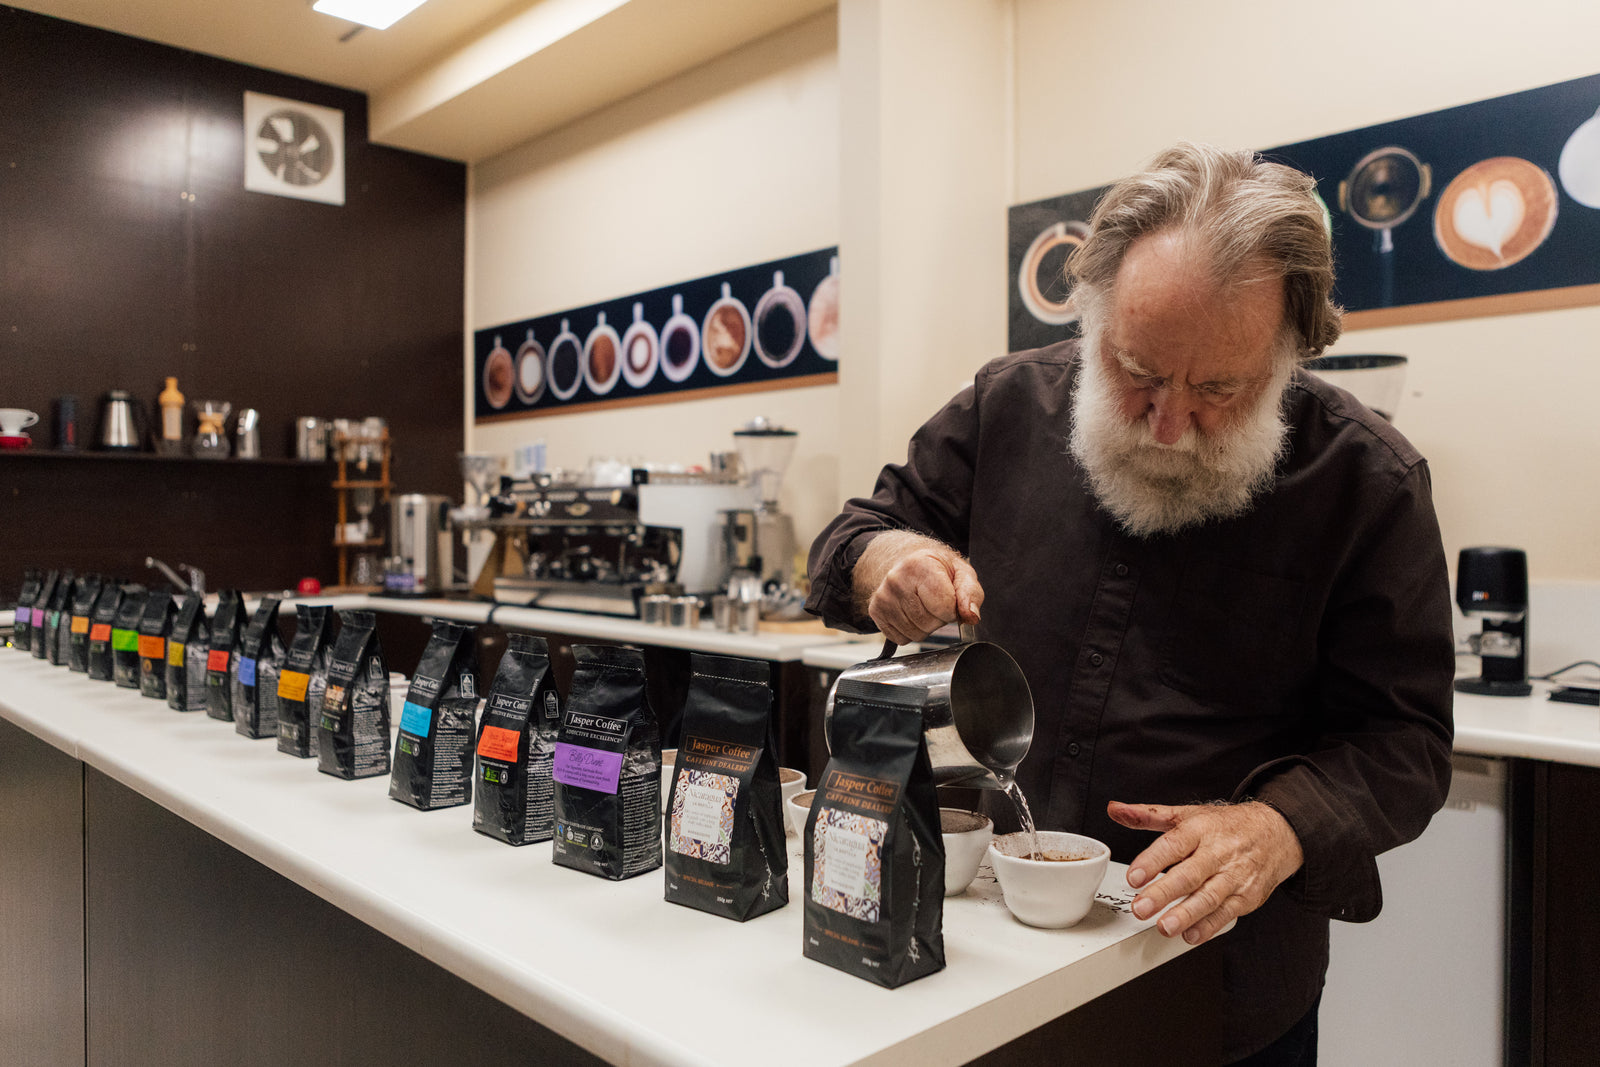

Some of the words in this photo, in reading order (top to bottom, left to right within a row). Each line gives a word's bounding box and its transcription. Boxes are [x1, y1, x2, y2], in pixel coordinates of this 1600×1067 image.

[570, 714, 594, 727] Jasper
[595, 718, 622, 732] Coffee
[566, 729, 589, 738] ADDICTIVE
[692, 739, 720, 754] Jasper
[722, 744, 751, 759] Coffee
[686, 755, 717, 767] CAFFEINE
[834, 774, 866, 792] Jasper
[867, 781, 894, 797] Coffee
[826, 792, 860, 807] CAFFEINE
